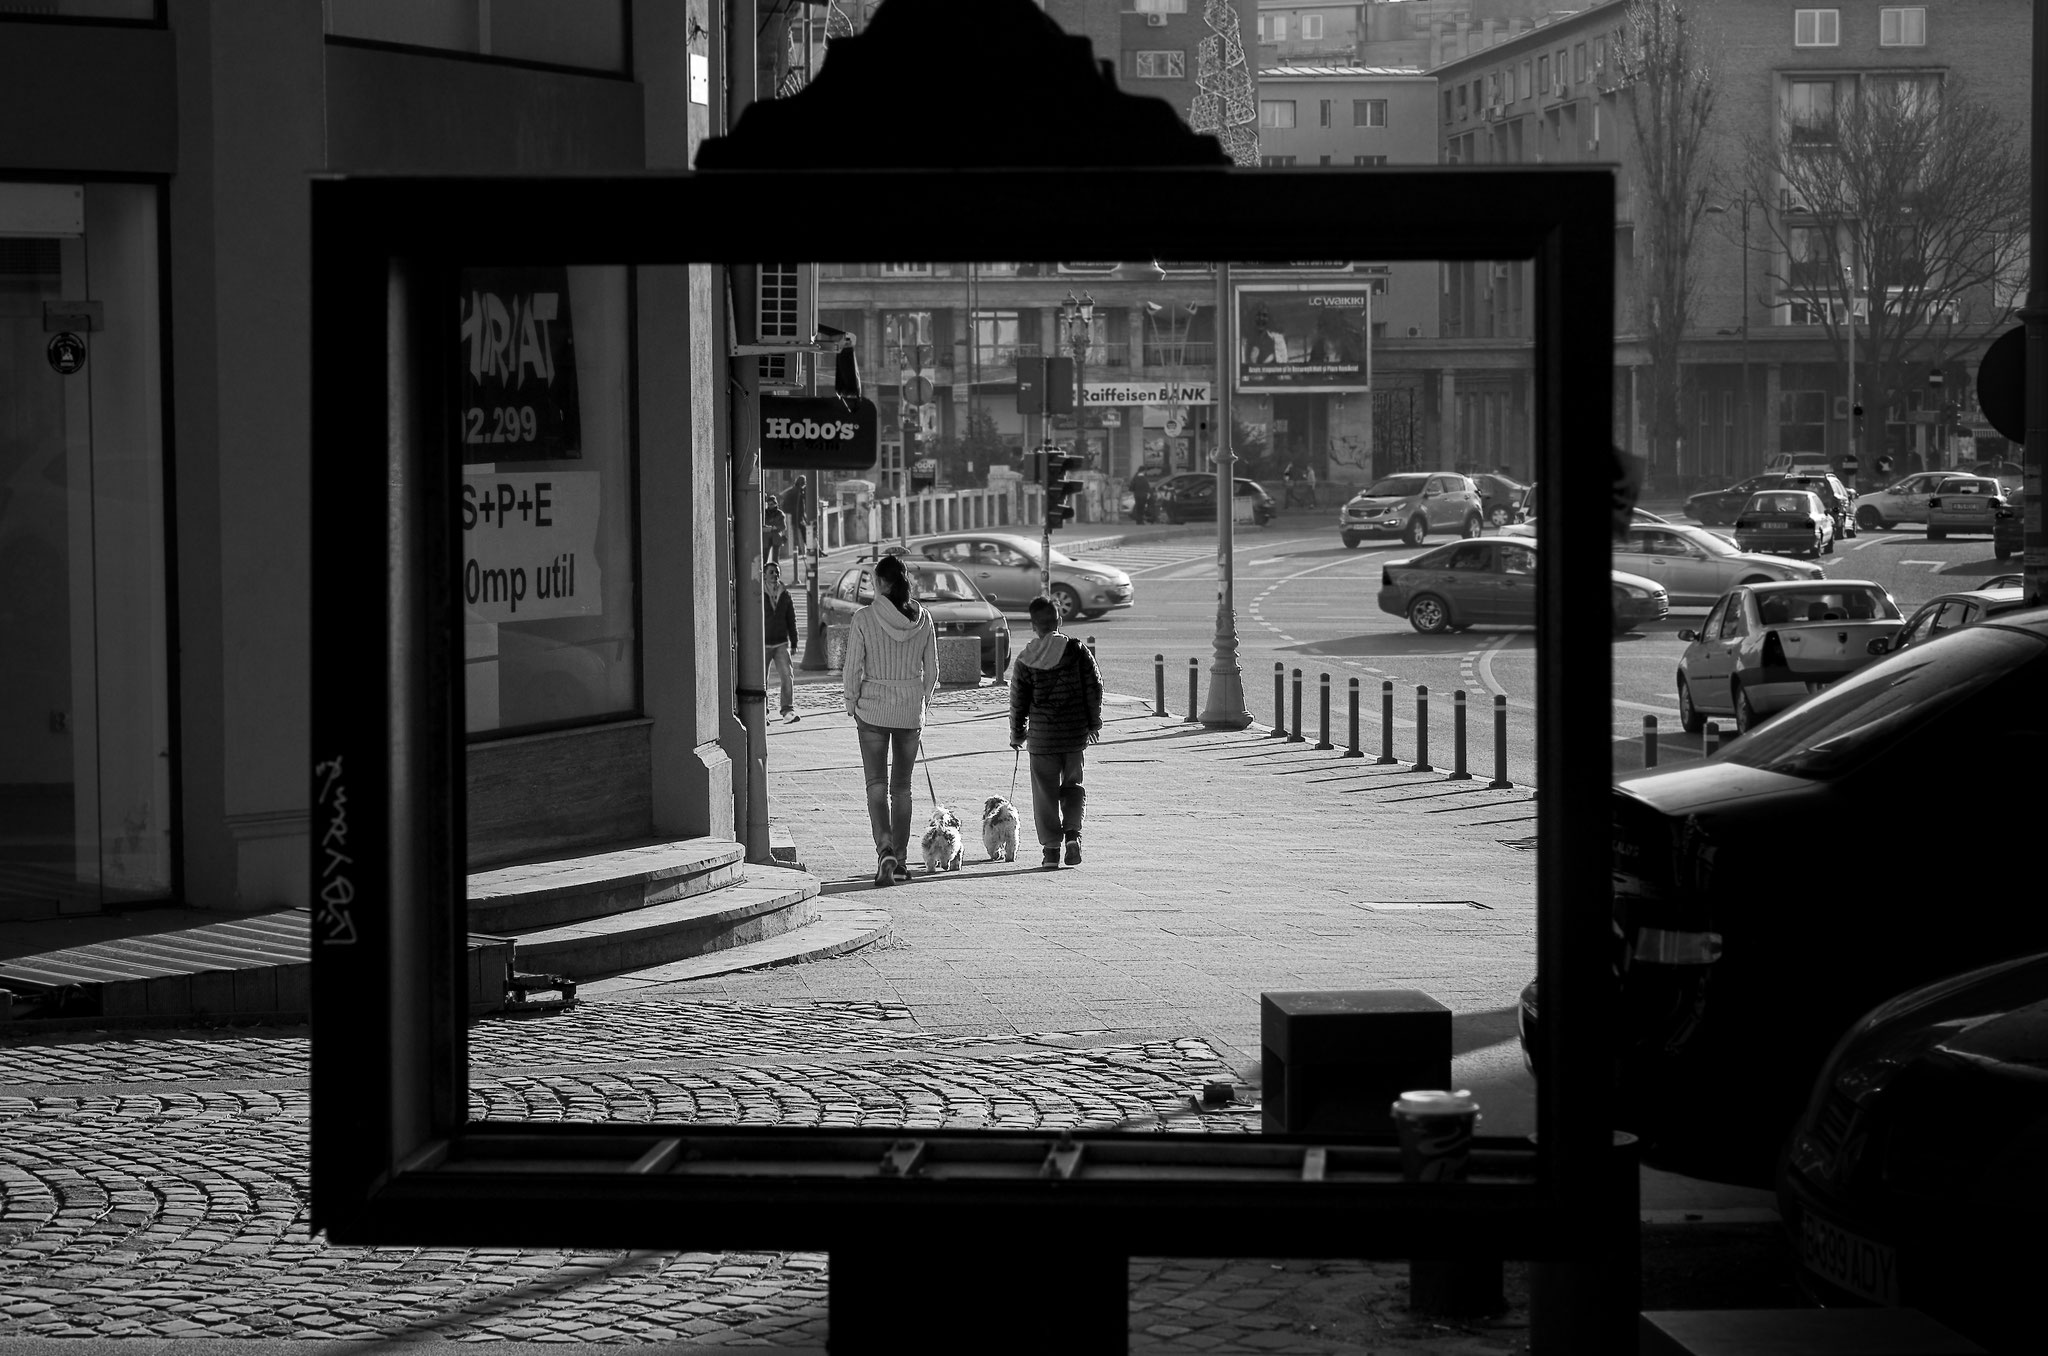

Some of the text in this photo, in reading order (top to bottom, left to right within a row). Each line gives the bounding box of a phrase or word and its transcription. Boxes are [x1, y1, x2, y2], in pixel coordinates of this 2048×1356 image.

[1308, 297, 1322, 306] LC
[1082, 388, 1157, 401] Raiffeisen
[1159, 388, 1206, 400] BANK
[461, 405, 537, 444] 2.299
[766, 418, 855, 440] Hobo's
[461, 483, 553, 531] S+P+E
[537, 553, 575, 600] util
[1851, 1239, 1894, 1299] ADY
